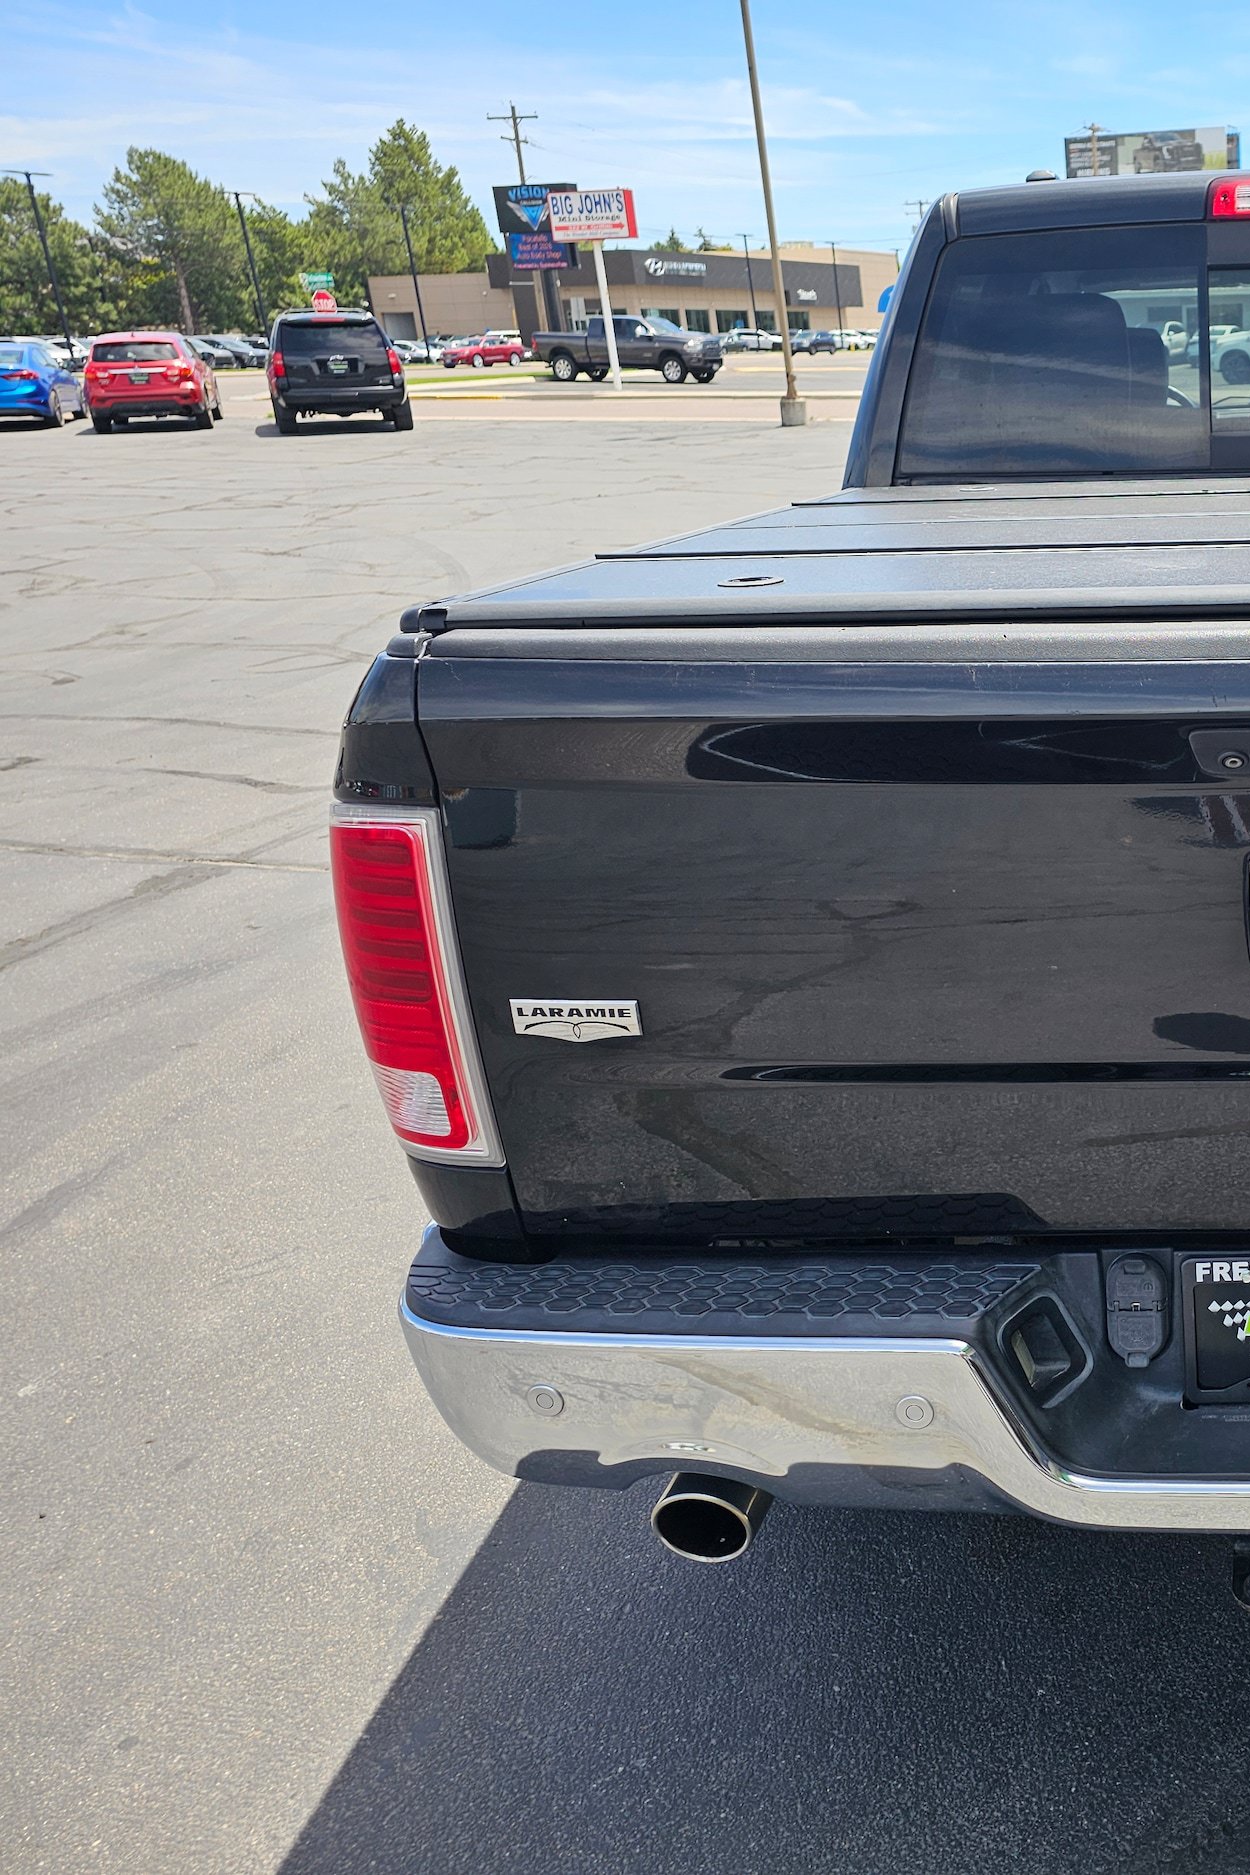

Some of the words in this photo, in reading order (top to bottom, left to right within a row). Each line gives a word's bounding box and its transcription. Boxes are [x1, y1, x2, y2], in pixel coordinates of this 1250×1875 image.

[551, 195, 573, 216] BIG
[578, 192, 624, 214] JOHN'S
[558, 215, 582, 223] Mini
[585, 214, 621, 223] Storage
[314, 298, 337, 311] STOP
[516, 1007, 632, 1018] LARAMIE
